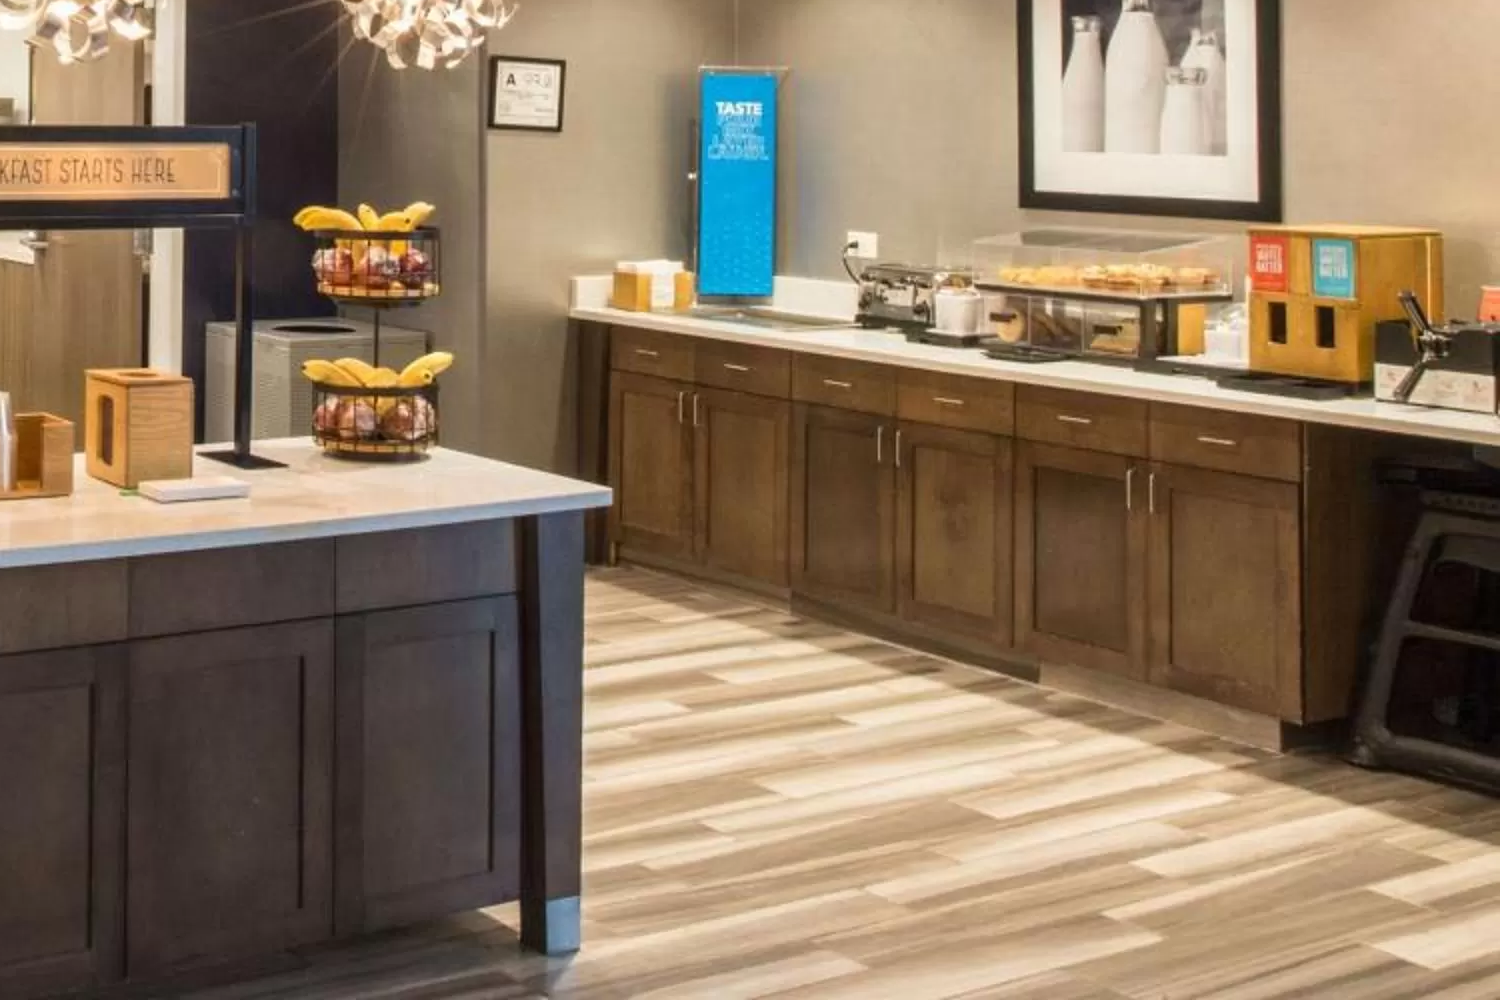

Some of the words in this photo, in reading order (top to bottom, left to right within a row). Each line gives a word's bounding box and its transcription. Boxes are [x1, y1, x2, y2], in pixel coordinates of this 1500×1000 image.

[715, 101, 763, 116] TASTE
[59, 157, 124, 184] STARTS
[131, 157, 176, 184] HERE
